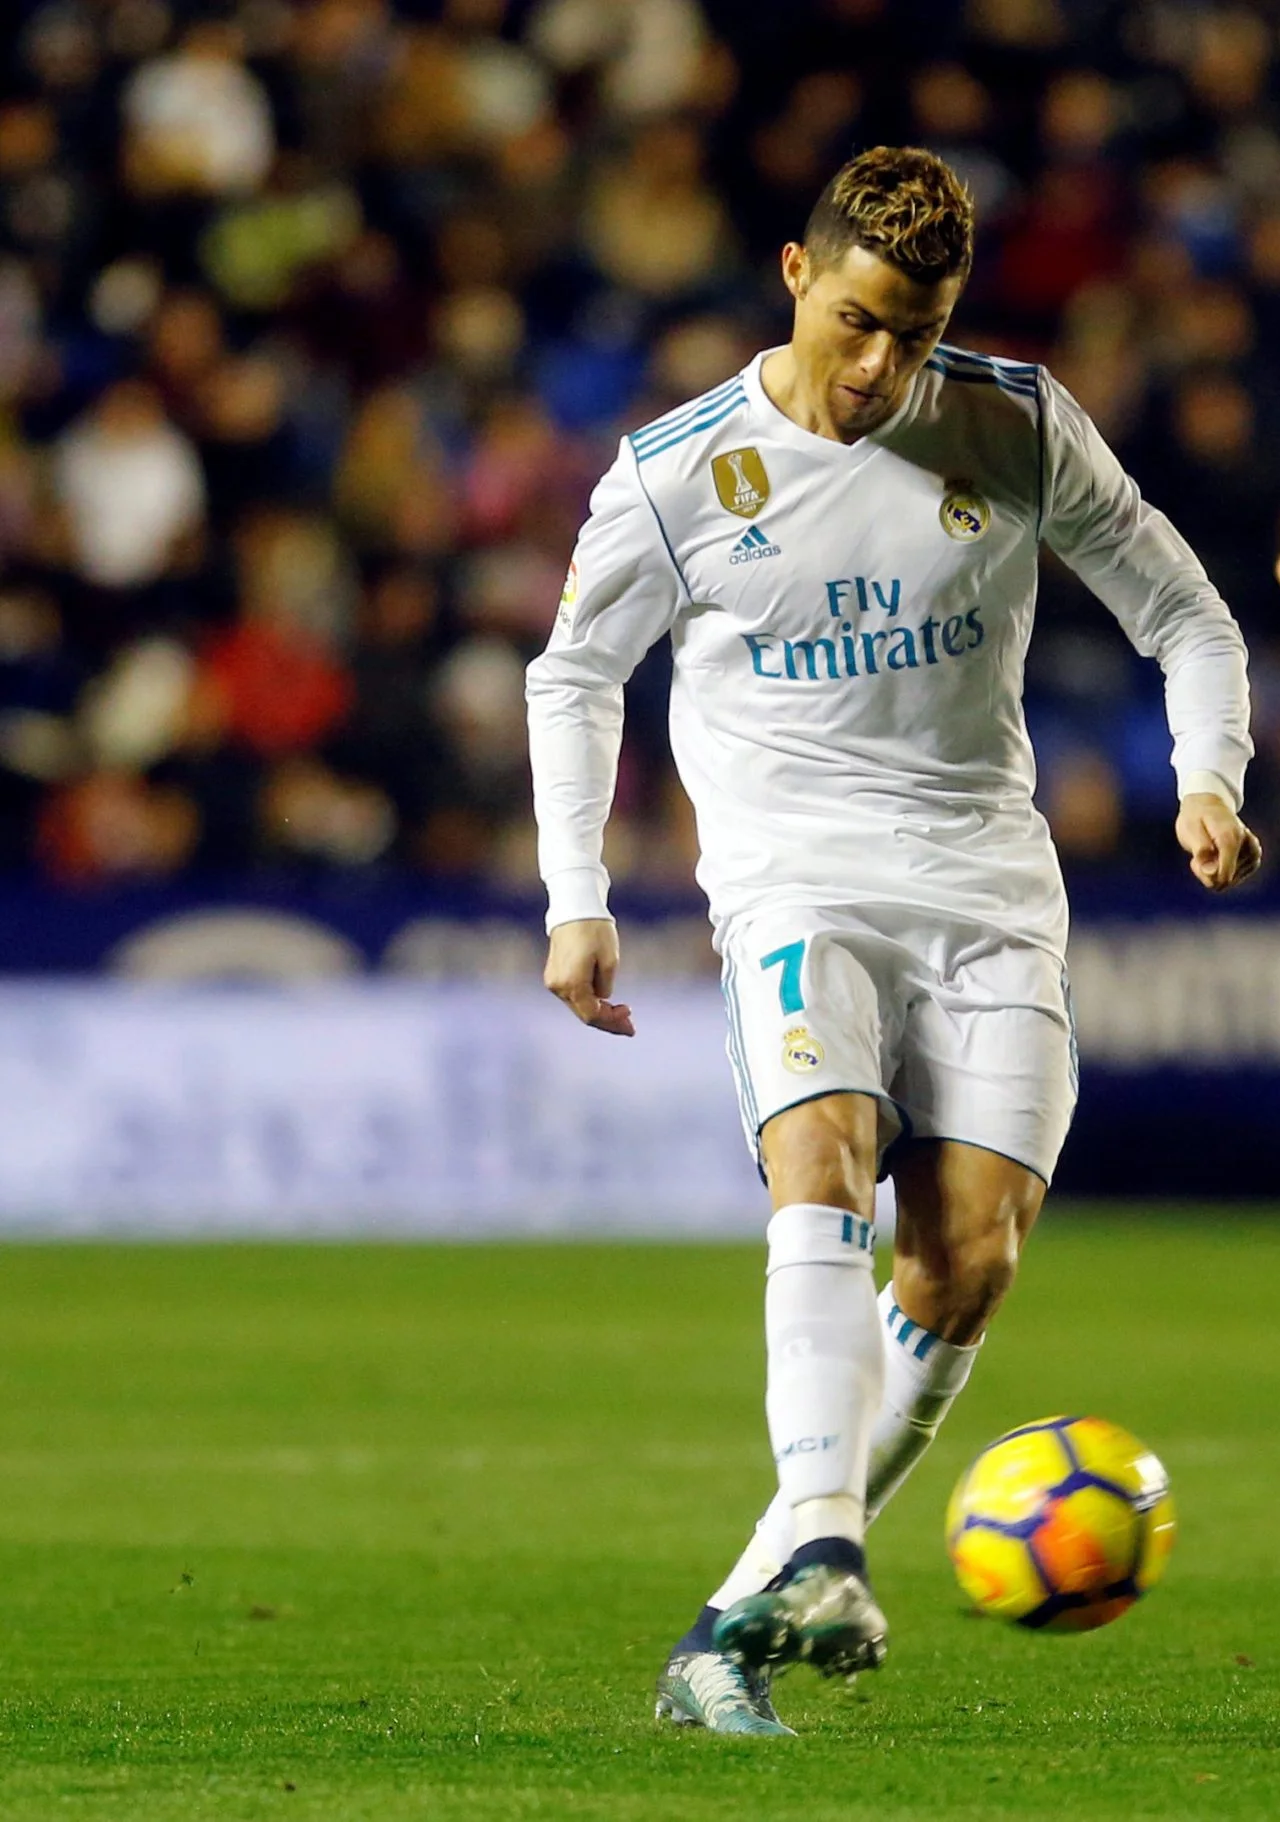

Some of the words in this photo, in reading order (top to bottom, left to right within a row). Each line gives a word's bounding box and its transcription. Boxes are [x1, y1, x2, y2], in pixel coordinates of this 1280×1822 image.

[734, 490, 759, 505] FIFA
[729, 543, 781, 565] adidas
[826, 576, 901, 617] Fly
[740, 605, 985, 680] Emirates
[760, 939, 806, 1016] 7
